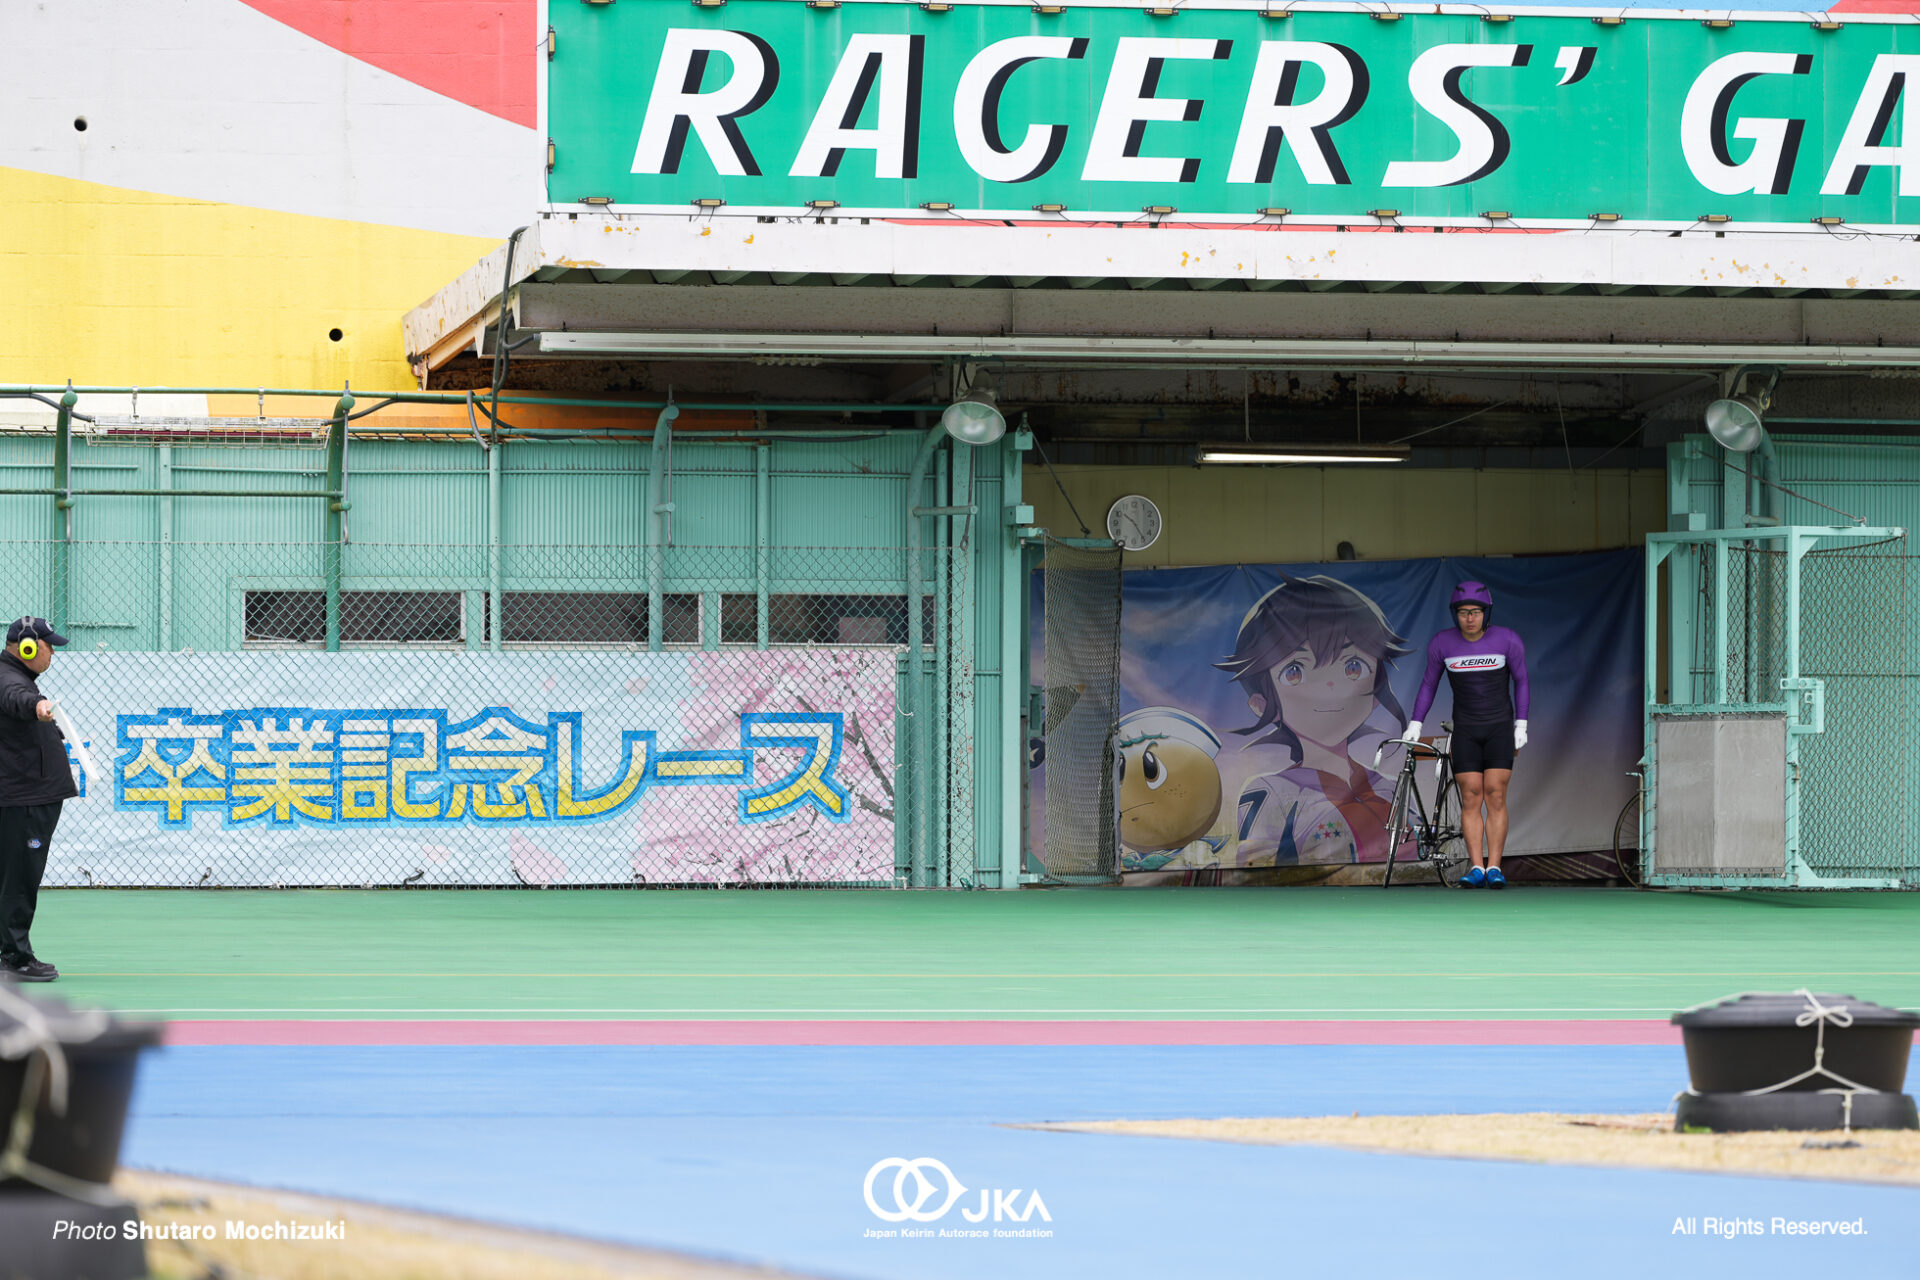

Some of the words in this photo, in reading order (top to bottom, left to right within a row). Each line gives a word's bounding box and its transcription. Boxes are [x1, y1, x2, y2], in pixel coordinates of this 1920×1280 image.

[1460, 658, 1497, 667] KEIRIN
[116, 707, 848, 827] 卒業記念レース
[1238, 788, 1269, 841] 7
